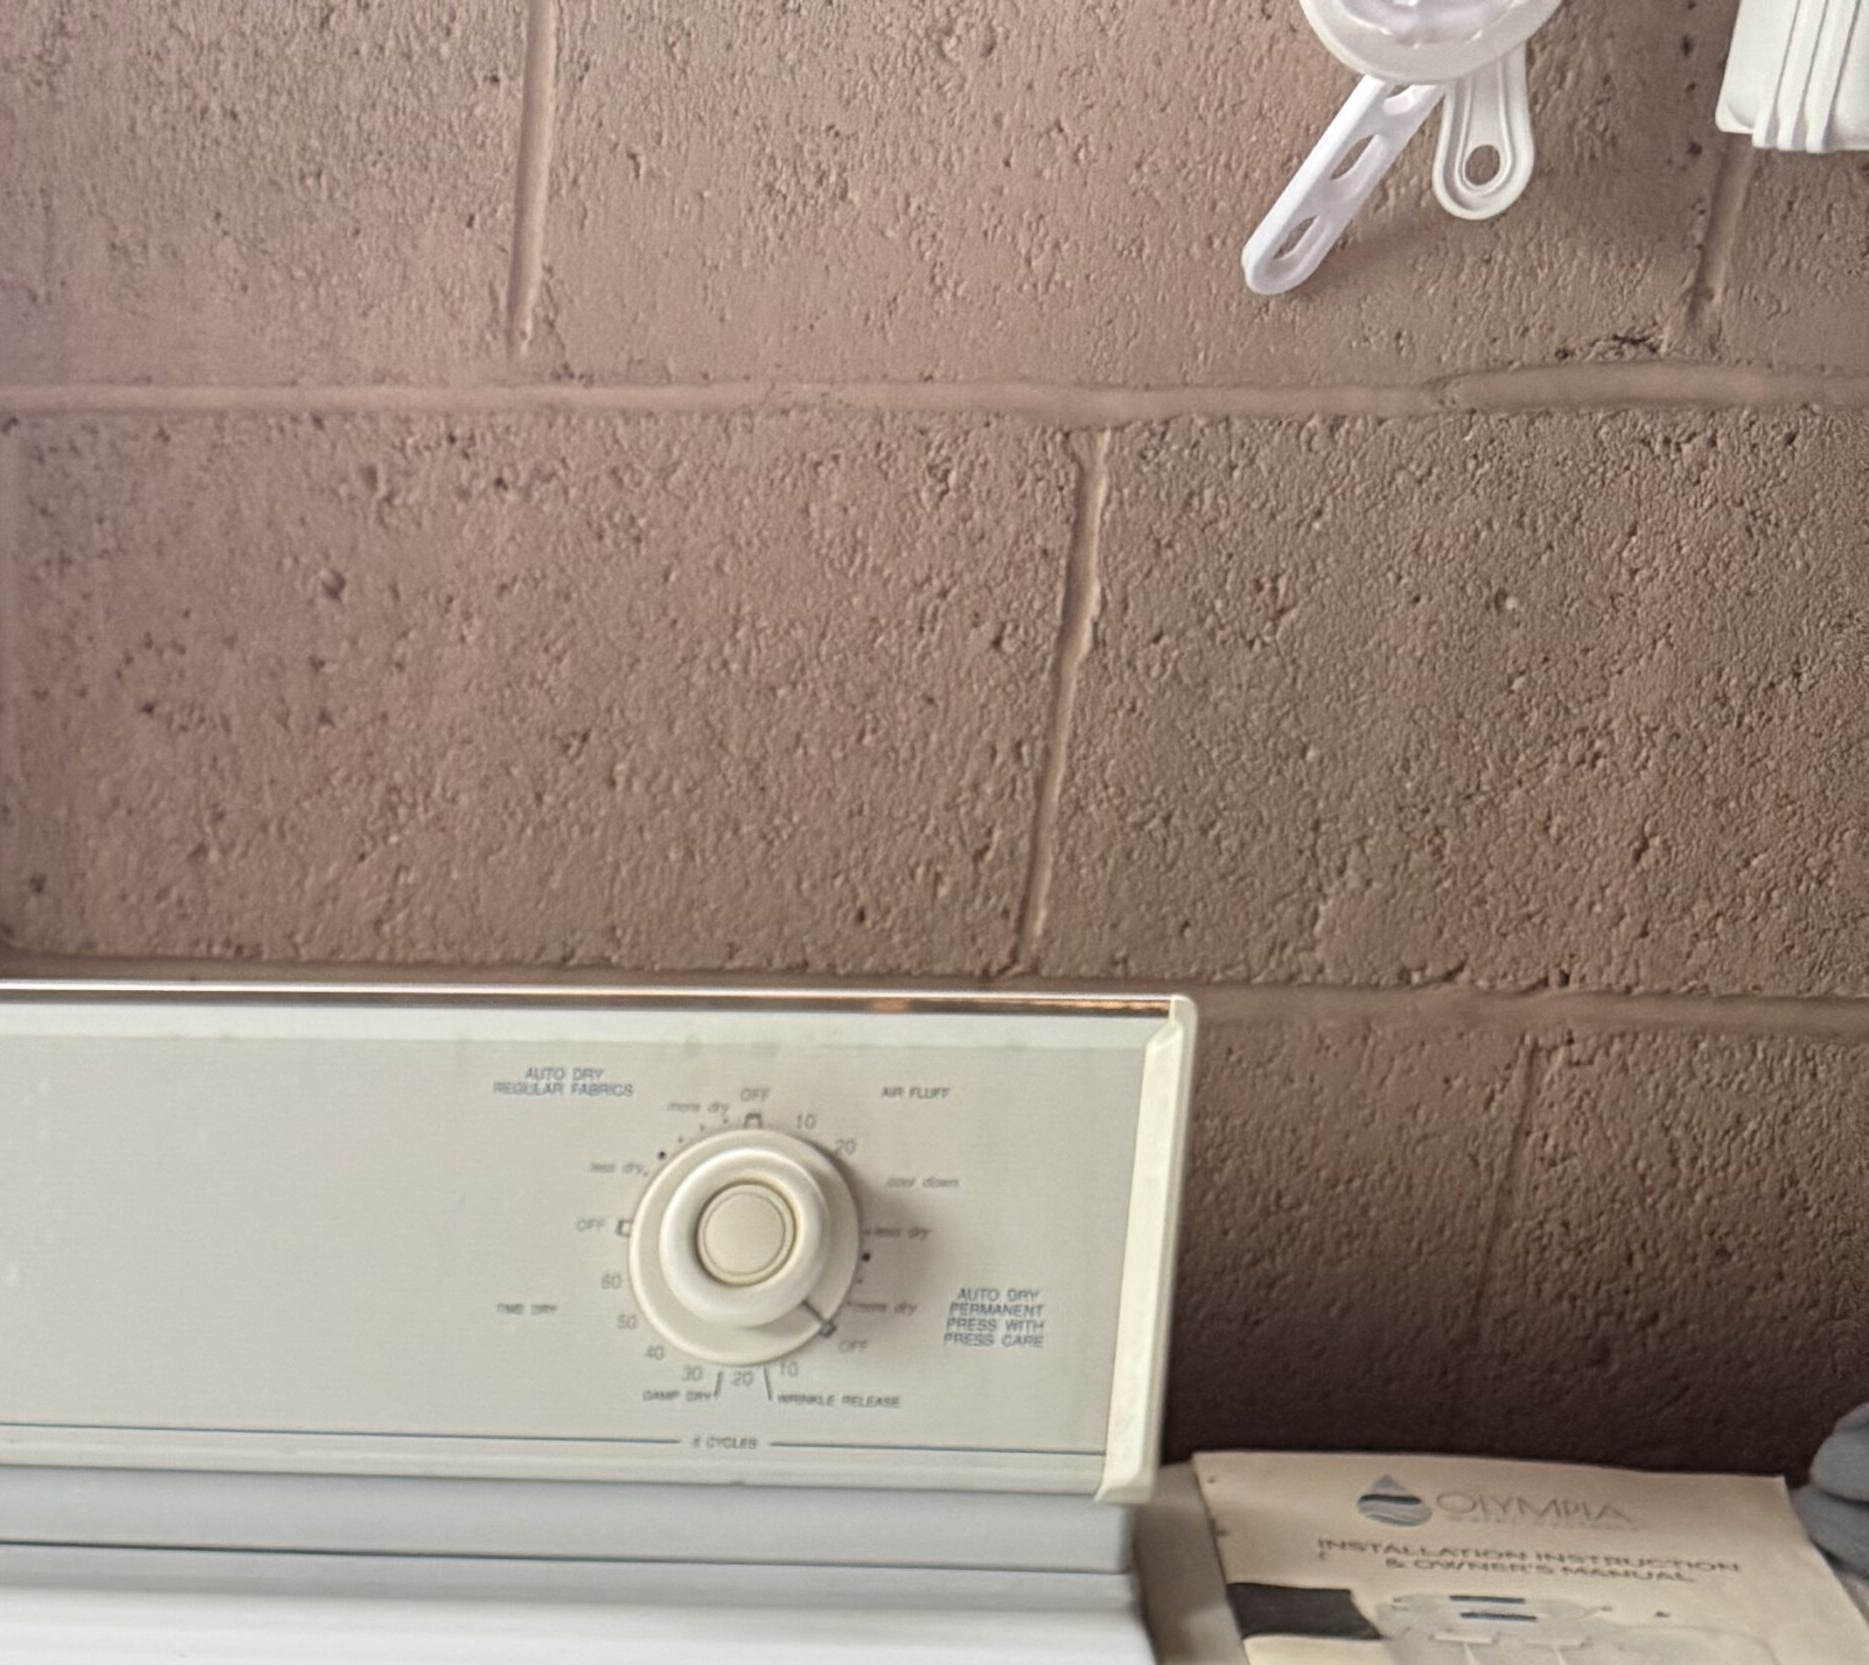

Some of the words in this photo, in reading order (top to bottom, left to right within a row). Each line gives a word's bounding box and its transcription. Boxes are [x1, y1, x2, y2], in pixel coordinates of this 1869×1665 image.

[525, 1067, 566, 1080] AUTO
[572, 1068, 604, 1081] DRY
[493, 1081, 564, 1096] REGULAR
[570, 1082, 634, 1097] FABRICS
[740, 1088, 770, 1102] OFF
[882, 1086, 905, 1099] AIR
[909, 1087, 950, 1100] FLUFF
[796, 1114, 817, 1131] 10
[835, 1137, 858, 1156] 20
[575, 1218, 606, 1231] OFF
[600, 1273, 623, 1290] 60
[958, 1288, 1000, 1301] AUTO
[1006, 1289, 1039, 1301] DRY
[949, 1303, 1044, 1317] PERMANENT
[617, 1313, 638, 1330] 50
[946, 1317, 998, 1331] PRESS
[1005, 1319, 1044, 1332] WITH
[944, 1333, 995, 1347] PRESS
[1001, 1334, 1044, 1348] CARE
[644, 1345, 665, 1361] 40
[682, 1366, 703, 1382] 30
[732, 1371, 754, 1388] 20
[841, 1396, 901, 1409] RELEASE
[706, 1436, 757, 1450] CYCLES
[1436, 1493, 1632, 1523] OLYMPIA
[1319, 1537, 1527, 1561] INSTALLATION
[1560, 1565, 1695, 1583] MANUAL
